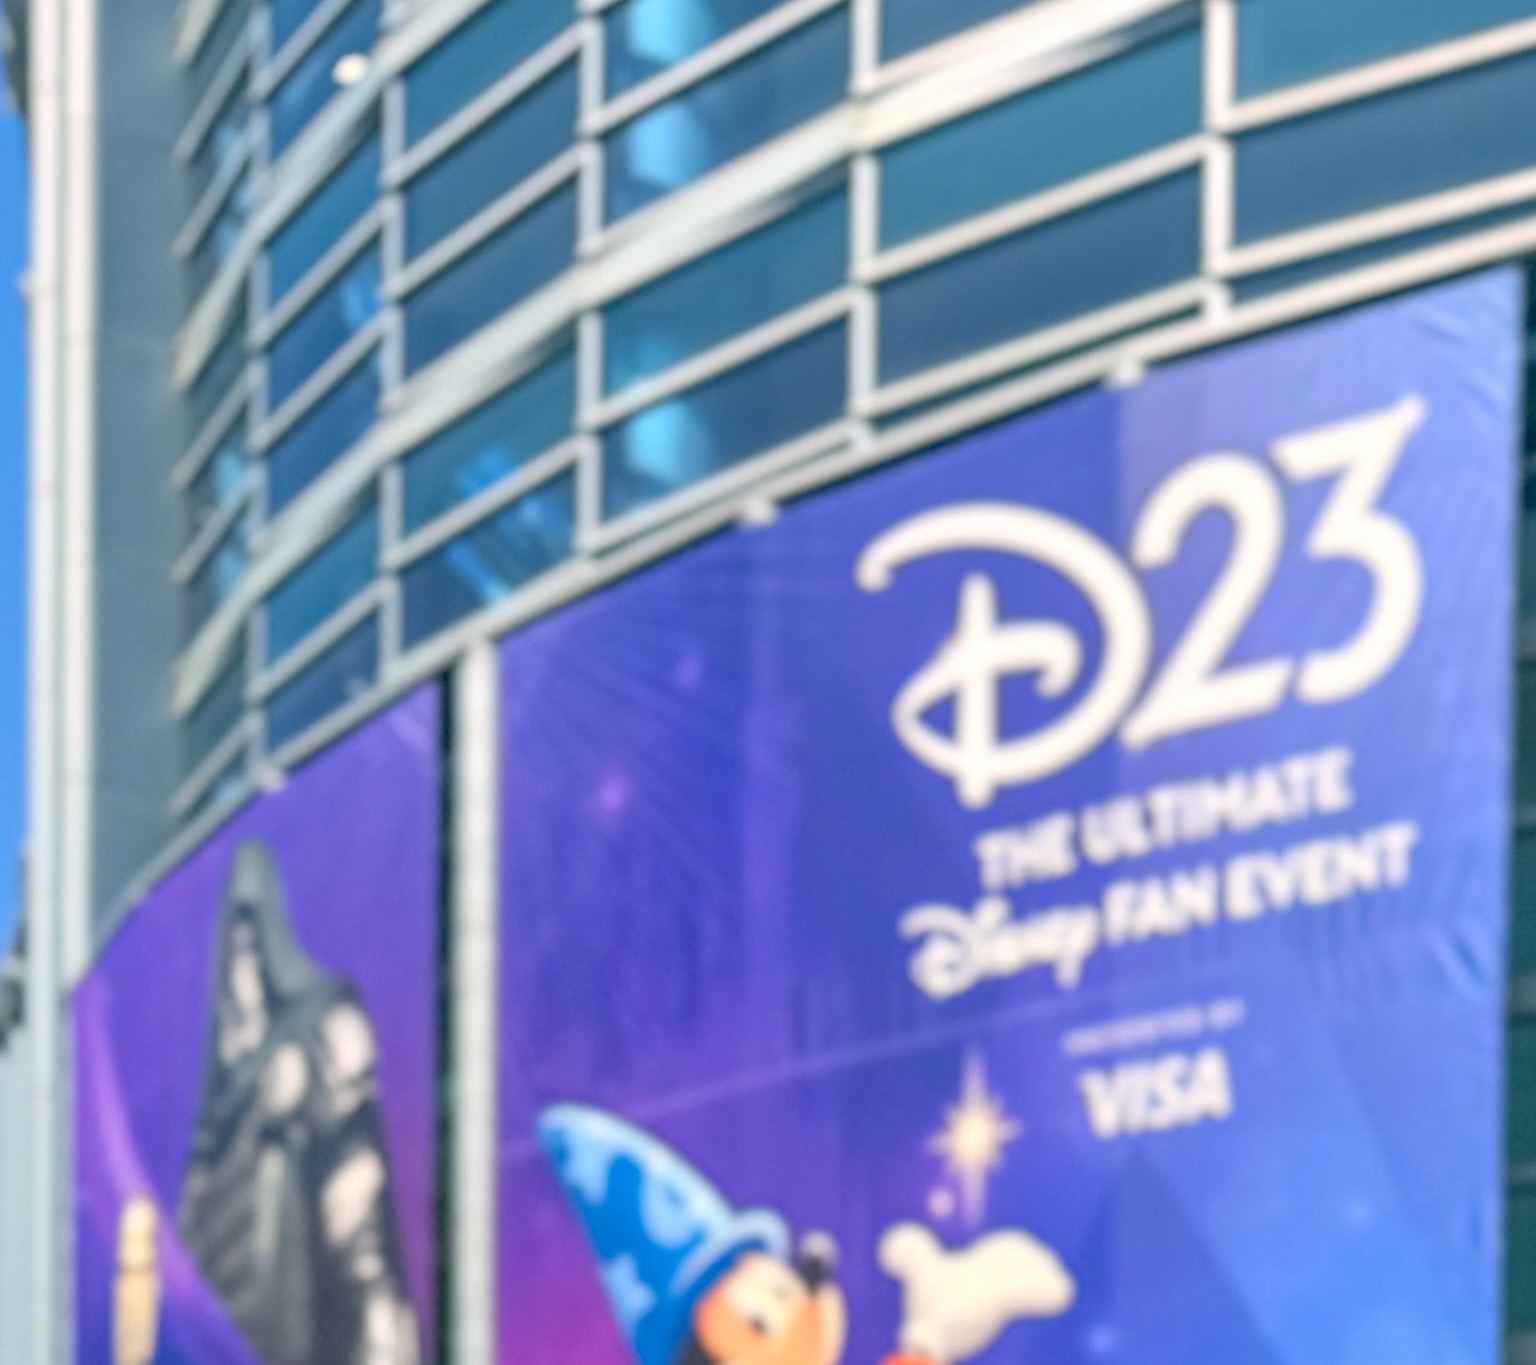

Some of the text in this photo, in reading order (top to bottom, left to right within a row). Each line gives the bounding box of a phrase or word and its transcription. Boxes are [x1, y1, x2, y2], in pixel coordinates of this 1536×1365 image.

[853, 393, 1427, 810] D23
[974, 745, 1353, 891] THE ULTIMATE
[898, 820, 1418, 1000] Disney FAN EVENT
[1080, 1047, 1235, 1141] VISA
